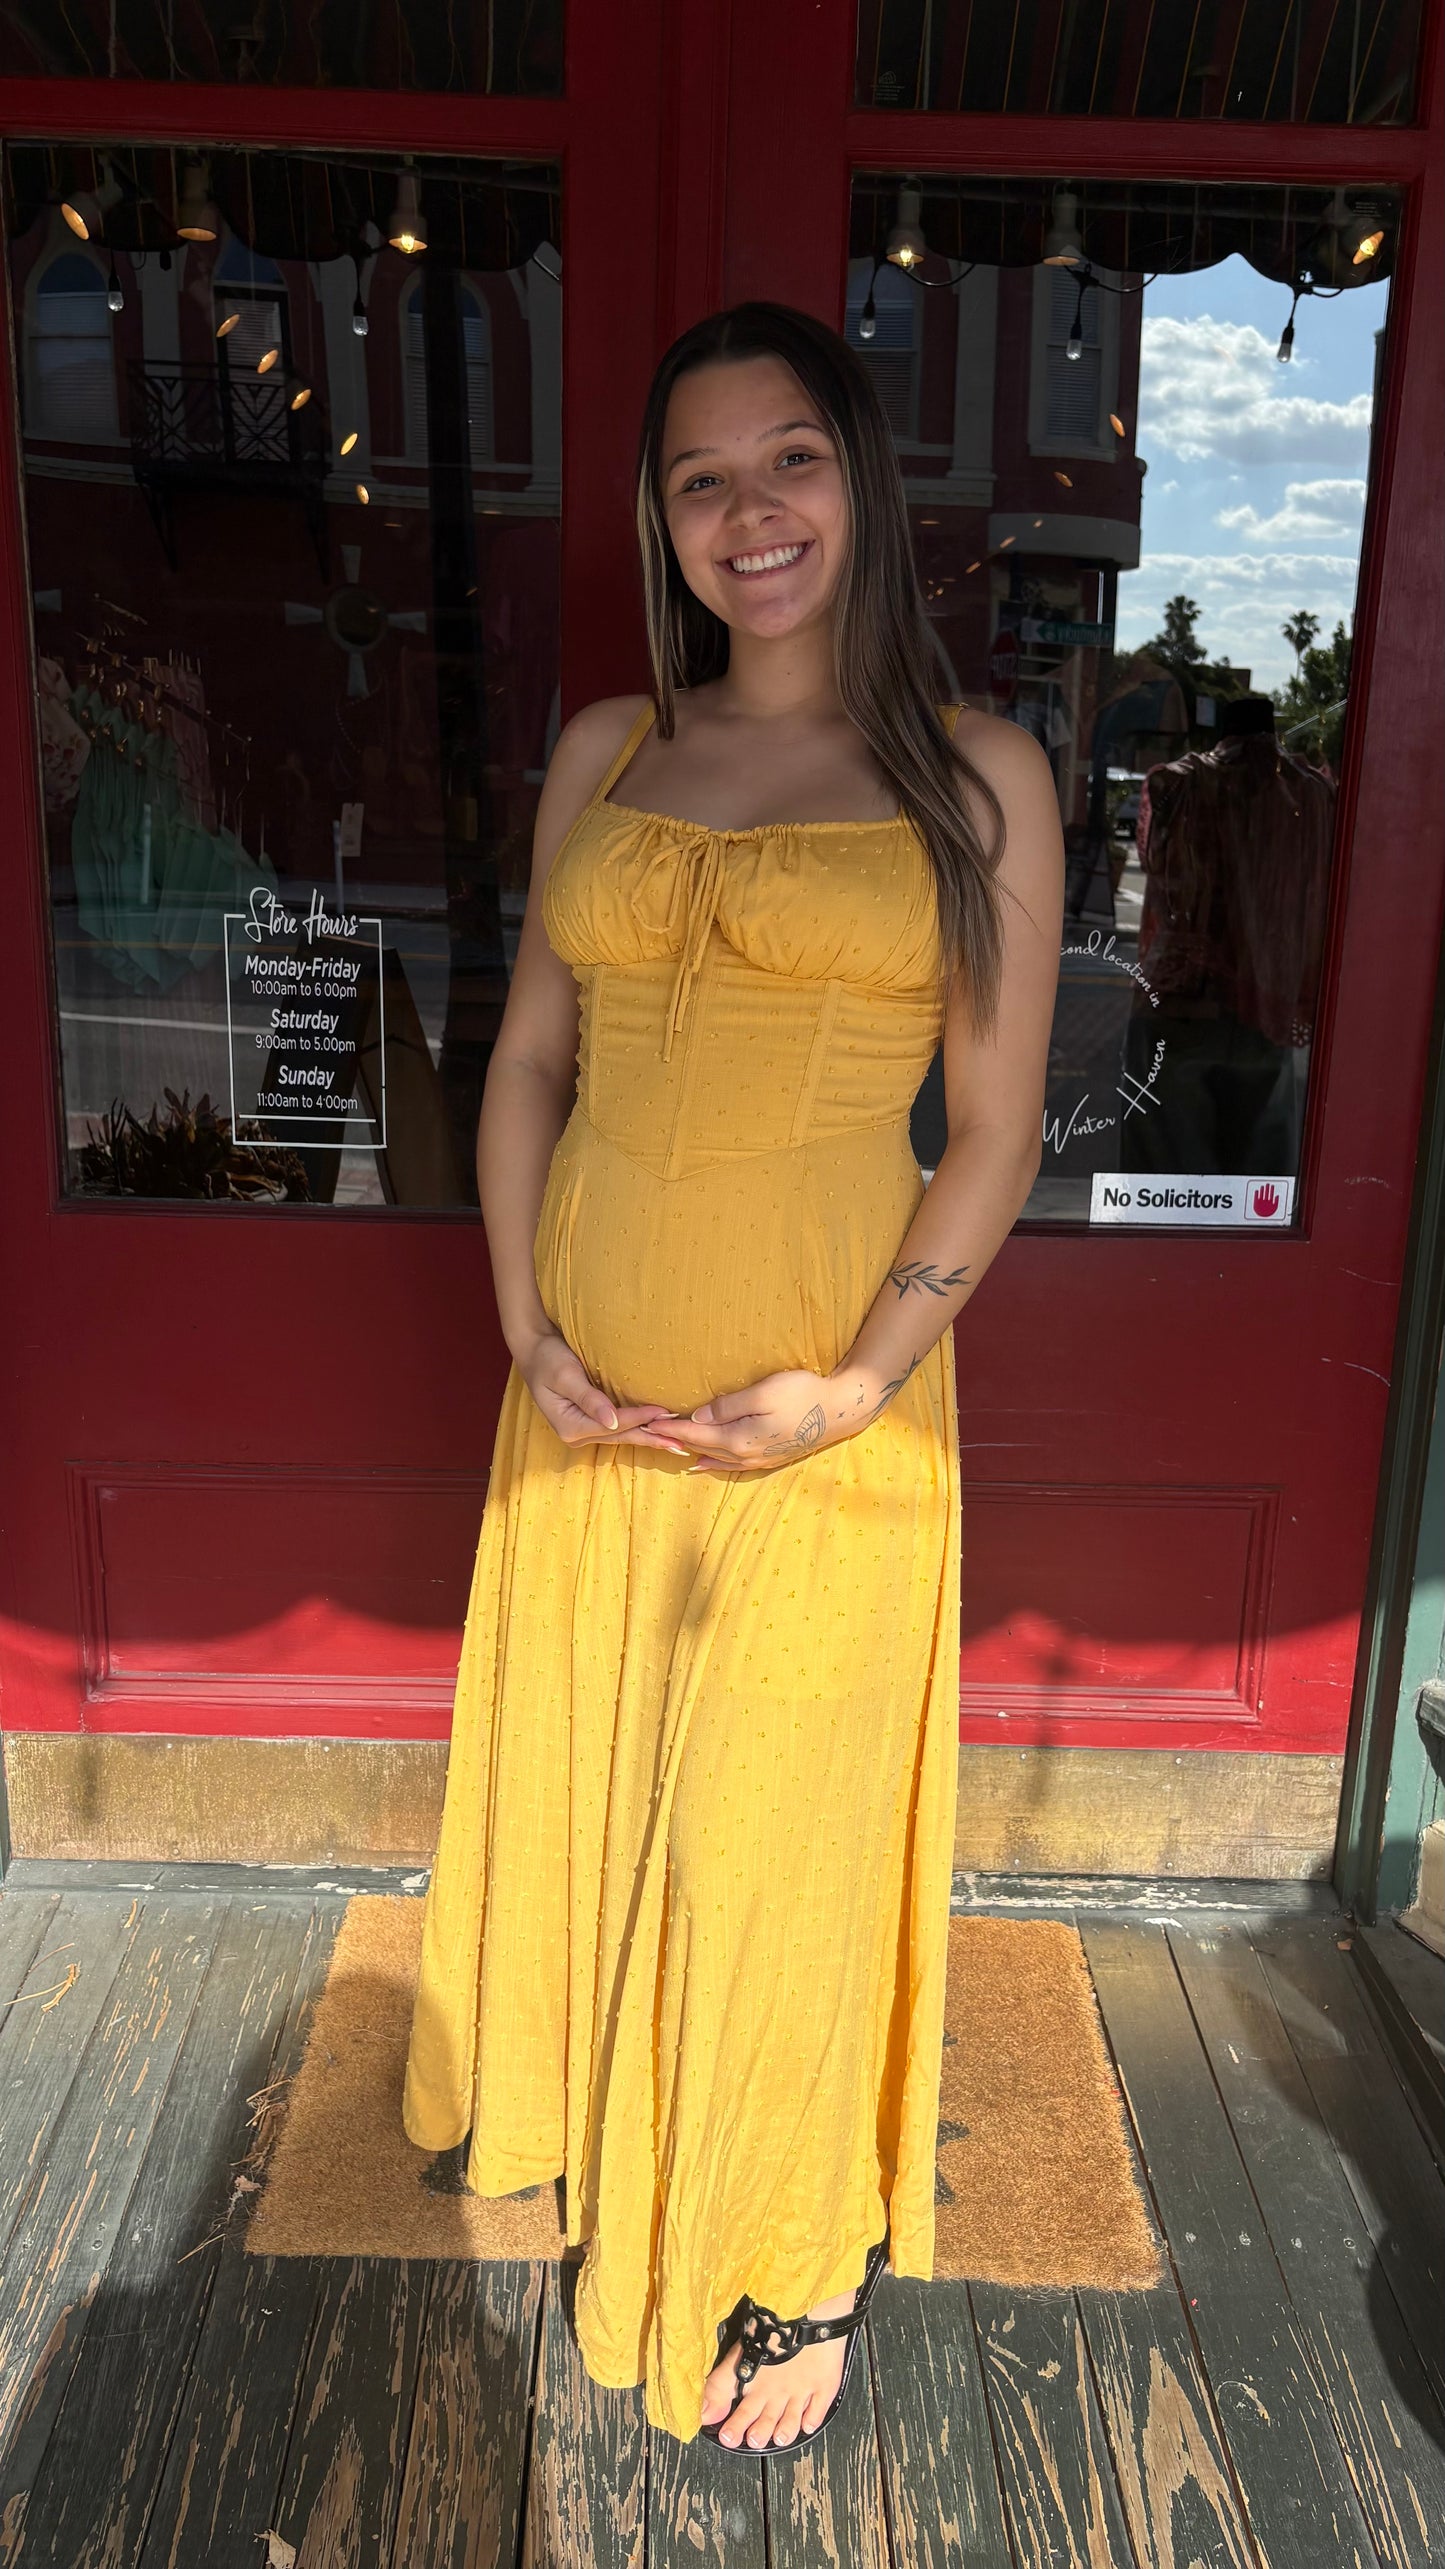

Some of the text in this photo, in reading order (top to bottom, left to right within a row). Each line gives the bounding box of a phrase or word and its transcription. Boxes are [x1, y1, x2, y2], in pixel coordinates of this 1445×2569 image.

[244, 886, 359, 945] Store Hours
[245, 955, 361, 983] Monday-Friday
[1103, 935, 1152, 992] location
[1149, 991, 1161, 1009] in
[251, 980, 357, 1000] 10:00am to 600pm
[270, 1009, 340, 1034] Saturday
[255, 1035, 297, 1050] 9:00am
[299, 1036, 312, 1051] to
[278, 1065, 335, 1090] Sunday
[256, 1093, 299, 1108] 11:00am
[301, 1094, 314, 1109] to
[1042, 1038, 1166, 1154] Winter Haven
[1103, 1187, 1233, 1209] No Solicitors
